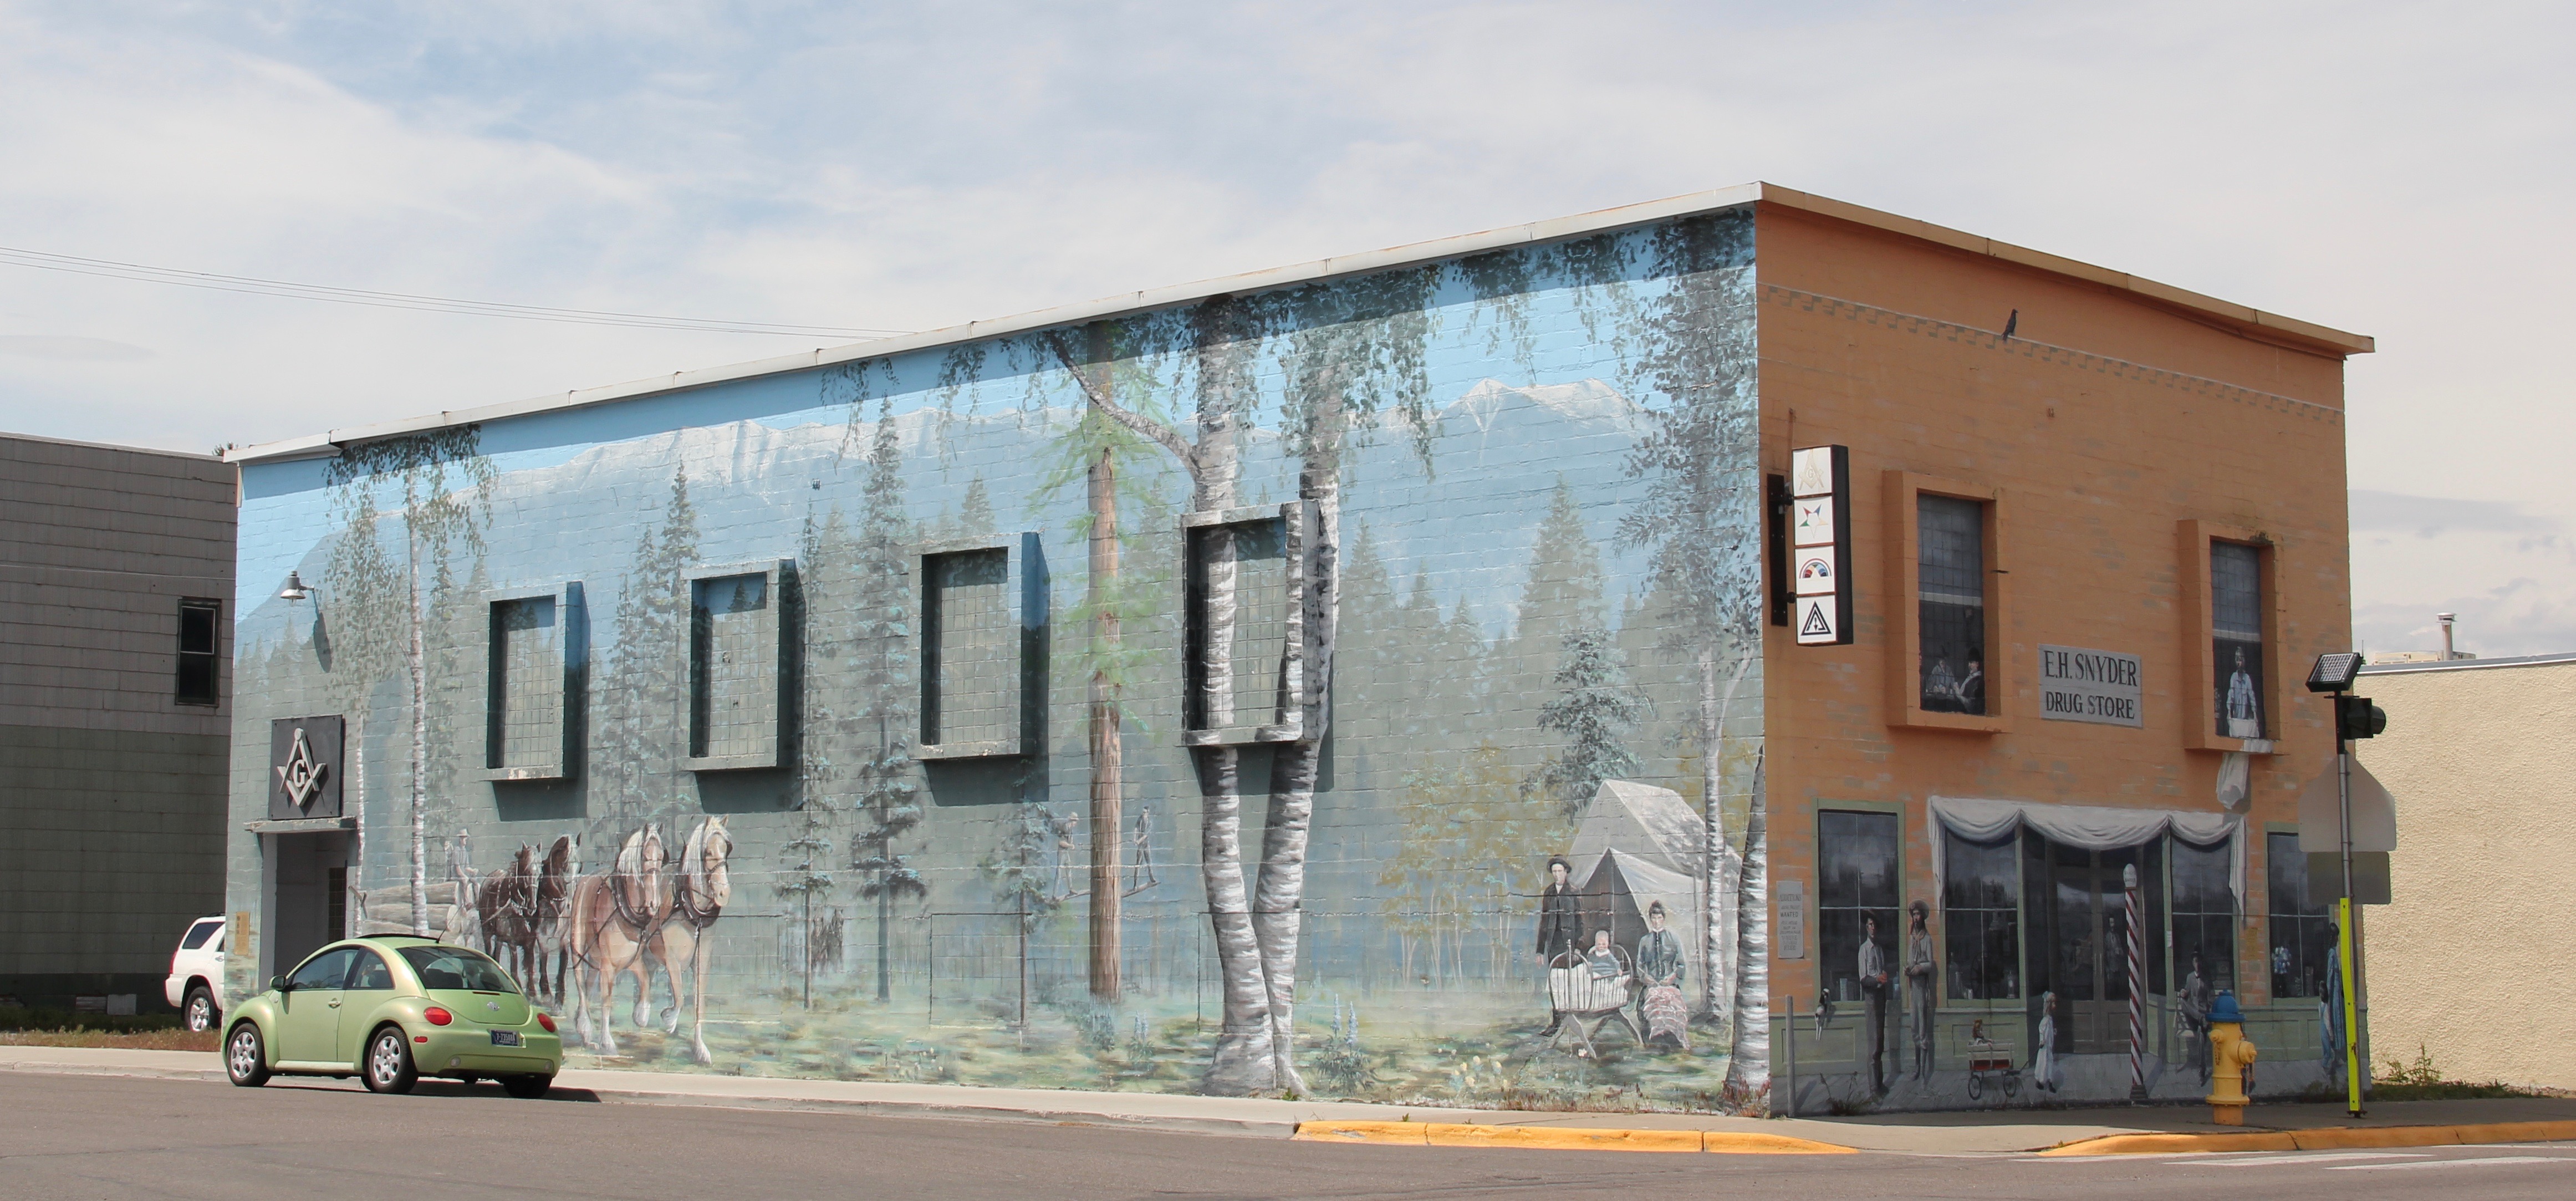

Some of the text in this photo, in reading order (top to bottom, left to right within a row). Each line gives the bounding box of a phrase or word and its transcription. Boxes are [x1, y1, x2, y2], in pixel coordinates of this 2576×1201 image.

[2044, 650, 2138, 686] E.H. SNYDER
[2046, 691, 2134, 719] DRUG STORE
[293, 759, 307, 787] G
